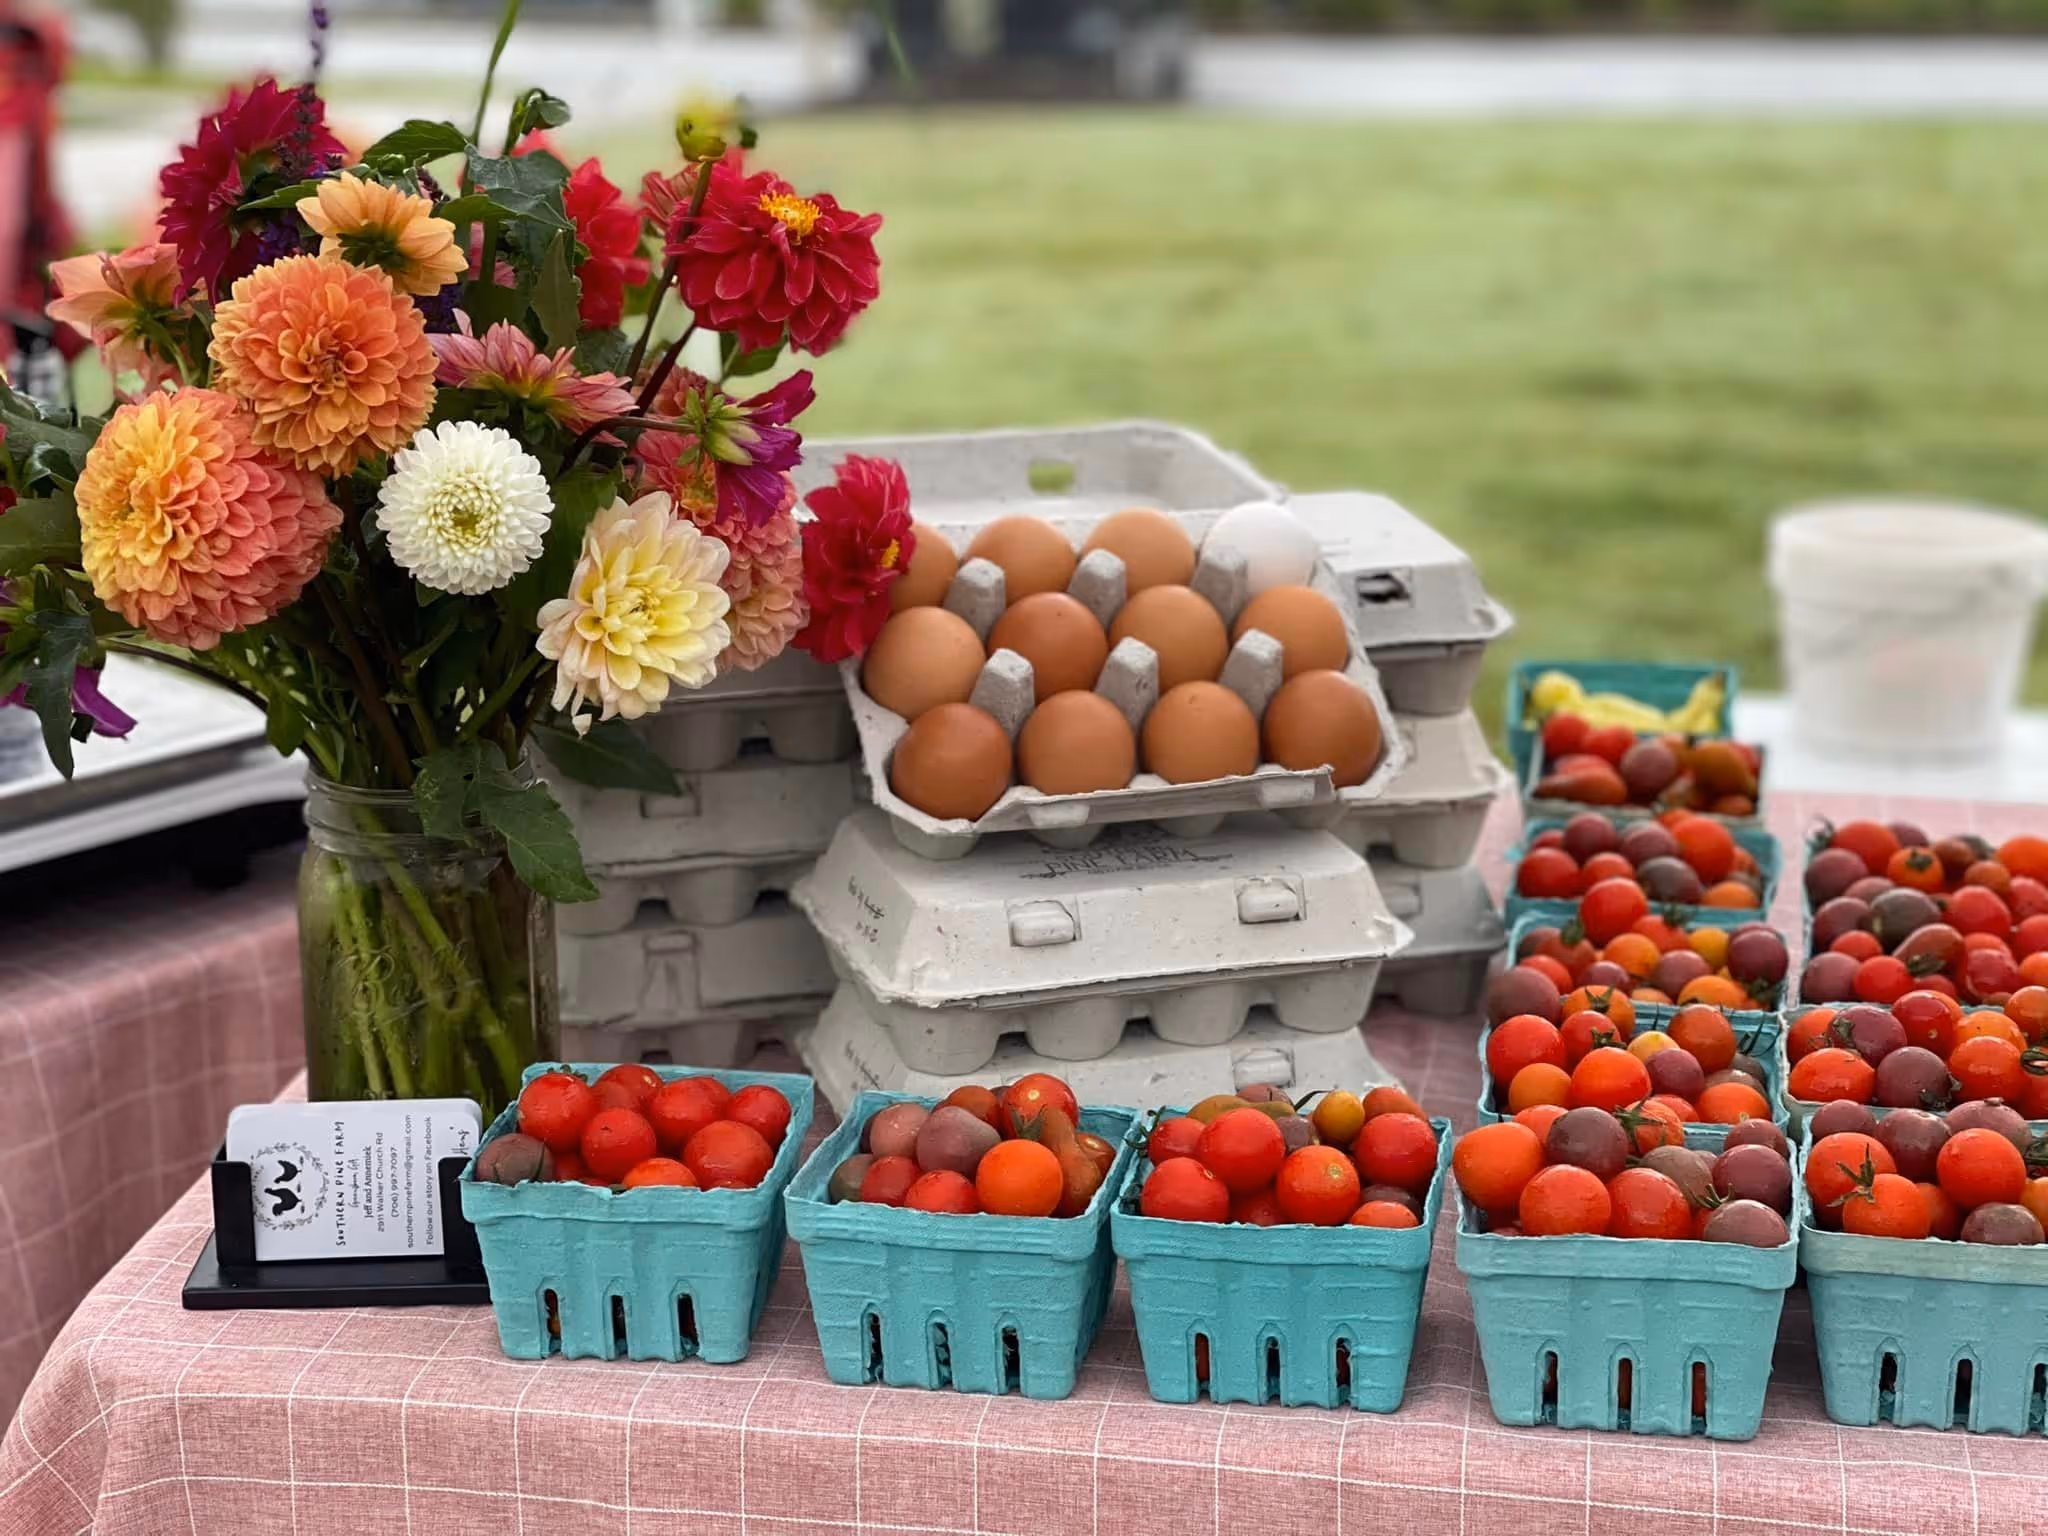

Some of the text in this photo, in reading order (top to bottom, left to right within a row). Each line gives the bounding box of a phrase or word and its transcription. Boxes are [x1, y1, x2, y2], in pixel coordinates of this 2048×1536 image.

[1045, 856, 1107, 874] PINE
[1116, 846, 1198, 864] FARM
[376, 1132, 384, 1144] Rd
[423, 1116, 432, 1160] Facebook
[376, 1146, 384, 1178] Church
[425, 1162, 432, 1173] on
[334, 1120, 346, 1246] SOUTHERN PINE FARM
[362, 1145, 374, 1217] Jeff and Annemiek
[404, 1114, 415, 1247] southernpinefarm@gmail.com
[424, 1175, 434, 1198] story
[376, 1181, 384, 1212] Walker
[390, 1192, 399, 1217] (706)
[424, 1216, 434, 1244] Follow
